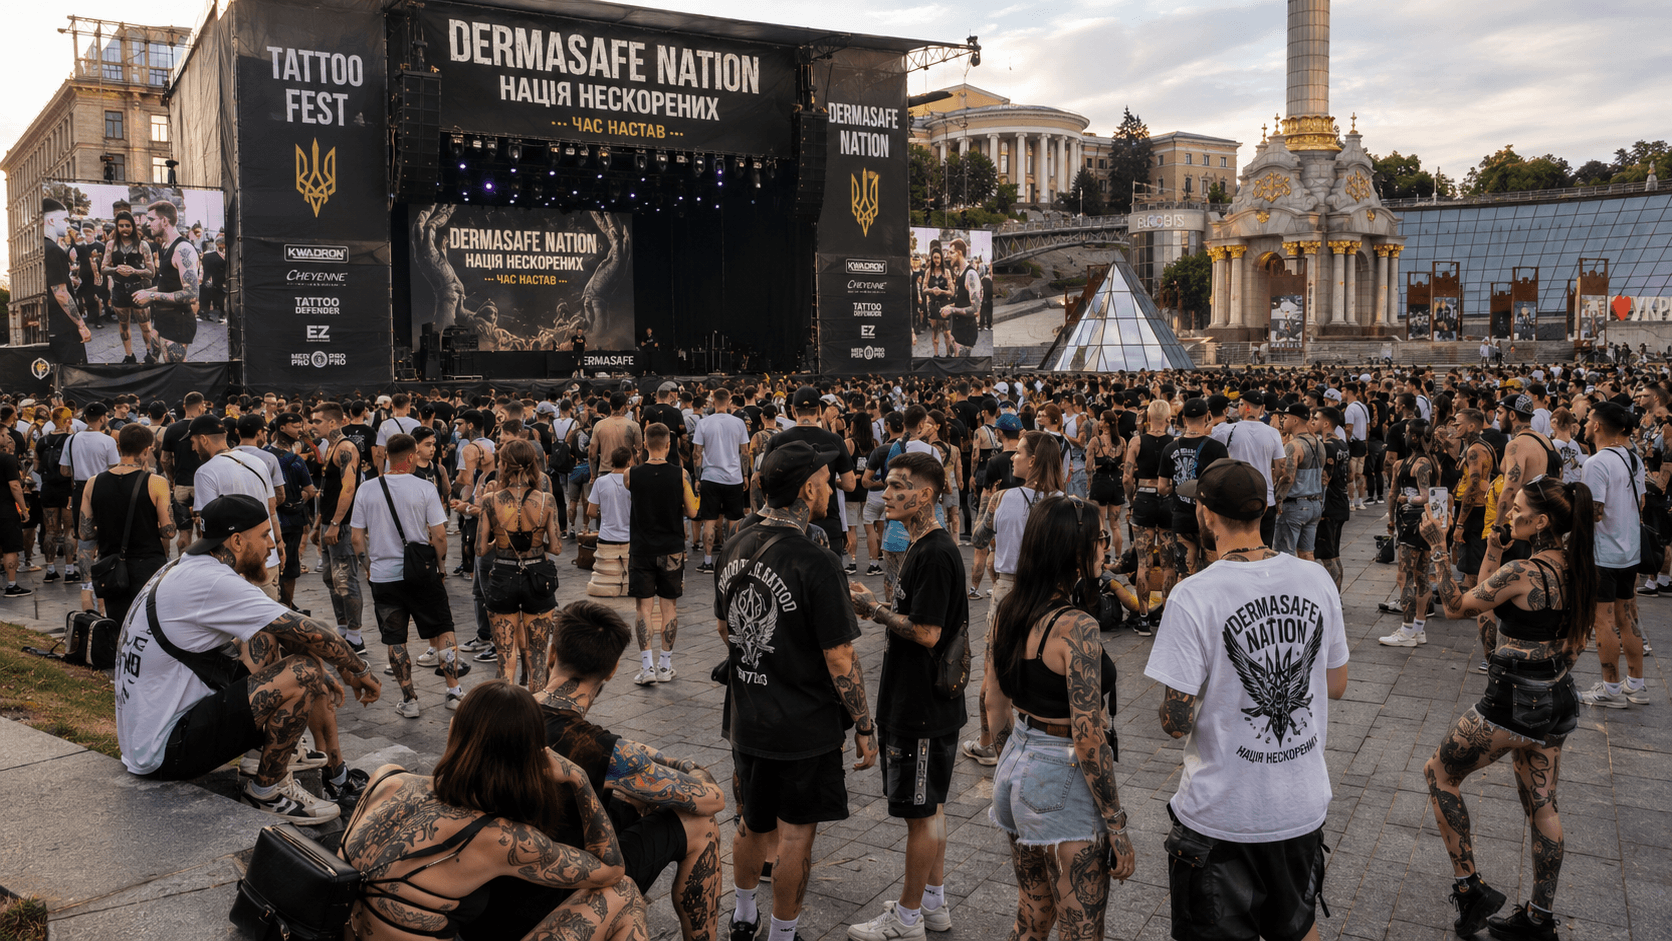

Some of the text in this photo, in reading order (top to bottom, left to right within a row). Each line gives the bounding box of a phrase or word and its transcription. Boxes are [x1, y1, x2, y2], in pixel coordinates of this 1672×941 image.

[267, 46, 363, 87] TATTOO
[449, 19, 760, 94] DERMASAFE NATION
[286, 89, 348, 126] FEST
[500, 75, 719, 121] НАЦІЯ НЕСКОРЕНИХ
[572, 116, 665, 138] ЧАС НАСТАВ
[828, 102, 899, 129] DERMASAFE
[840, 130, 889, 158] NATION
[450, 228, 597, 254] DERMASAFE NATION
[287, 247, 344, 260] KWADRON
[465, 253, 584, 271] НАЦІЯ НЕСКОРЕНИХ
[496, 275, 557, 285] ЧАС НАСТАВ
[295, 297, 340, 306] TATTOO
[853, 302, 882, 310] TATTOO
[306, 325, 330, 339] EZ
[861, 325, 875, 336] EZ
[1226, 594, 1319, 636] DERMASAFE
[1245, 618, 1307, 653] NATION
[1236, 745, 1264, 764] НАЦІЯ
